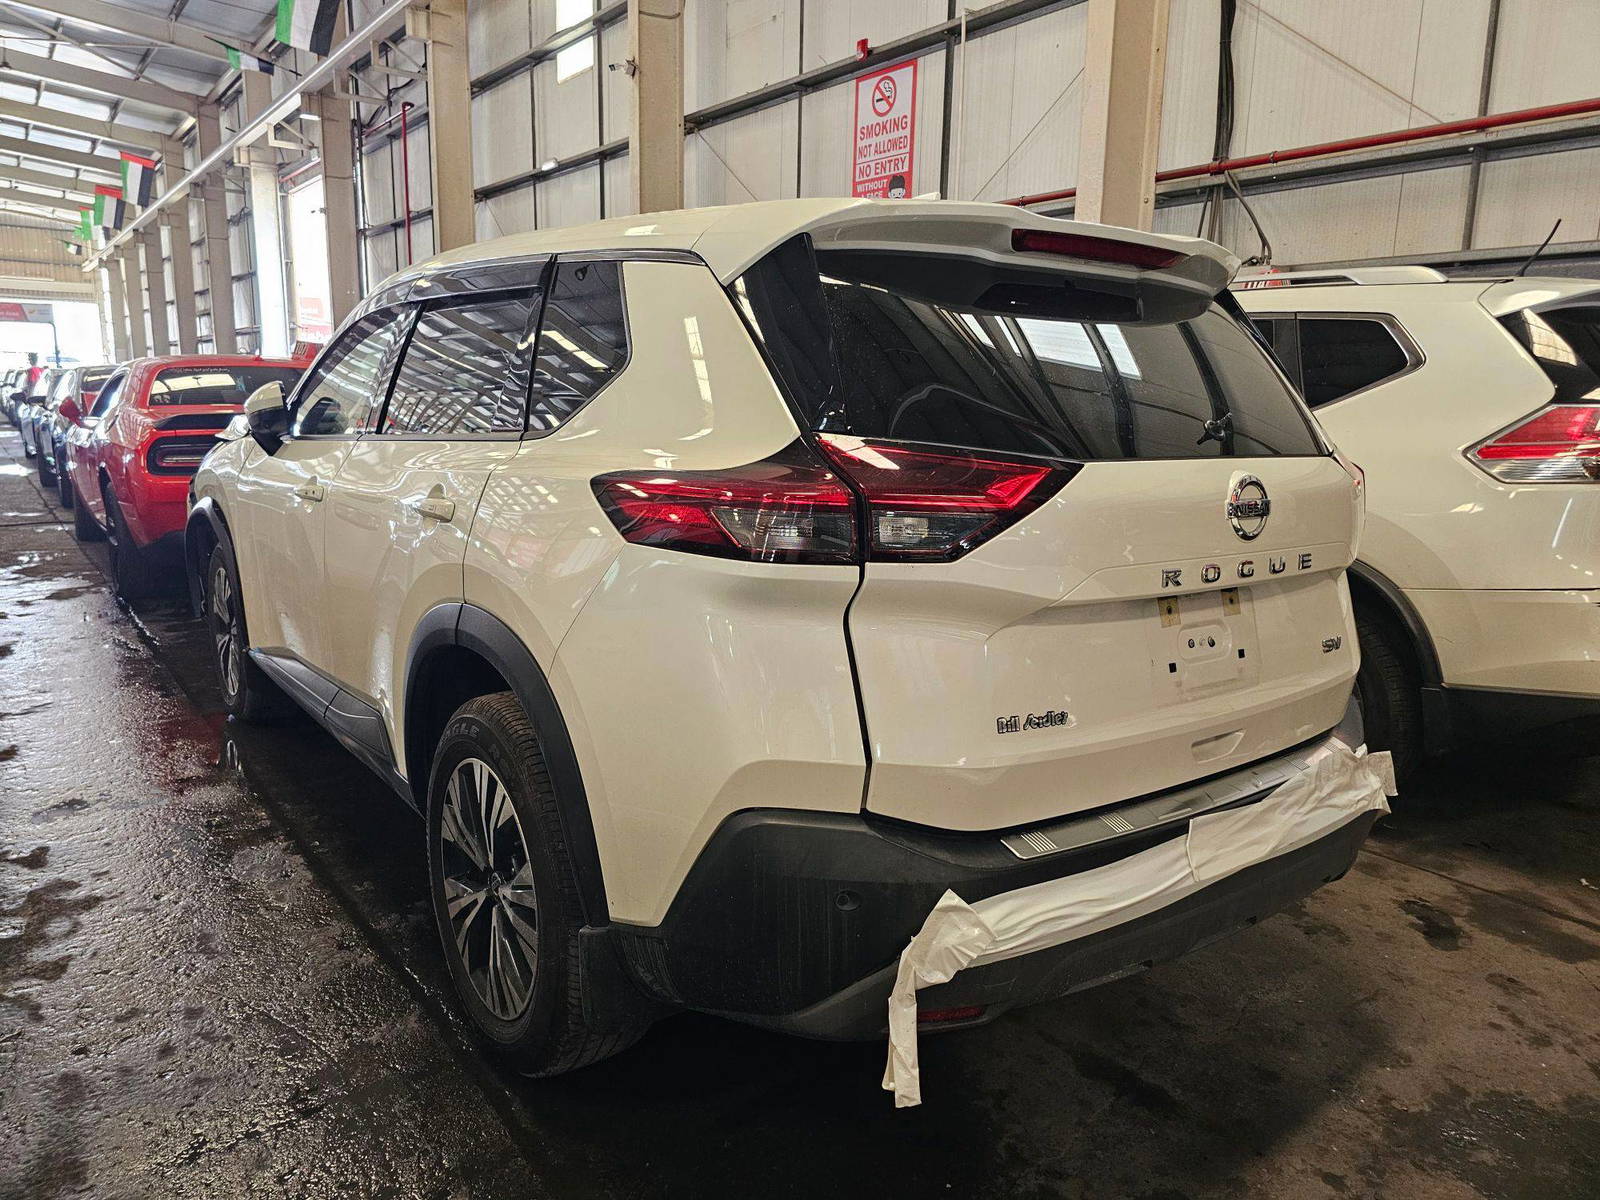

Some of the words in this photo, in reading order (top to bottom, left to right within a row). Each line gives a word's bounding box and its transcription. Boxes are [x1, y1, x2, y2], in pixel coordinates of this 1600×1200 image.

[859, 115, 908, 141] SMOKING
[858, 144, 872, 160] NOT
[873, 135, 908, 155] ALLOWED
[858, 164, 871, 179] NO
[874, 156, 907, 176] ENTRY
[857, 179, 888, 192] WITHOUT
[1161, 553, 1312, 588] ROGUE
[1322, 635, 1342, 653] SV
[997, 715, 1020, 734] Bill
